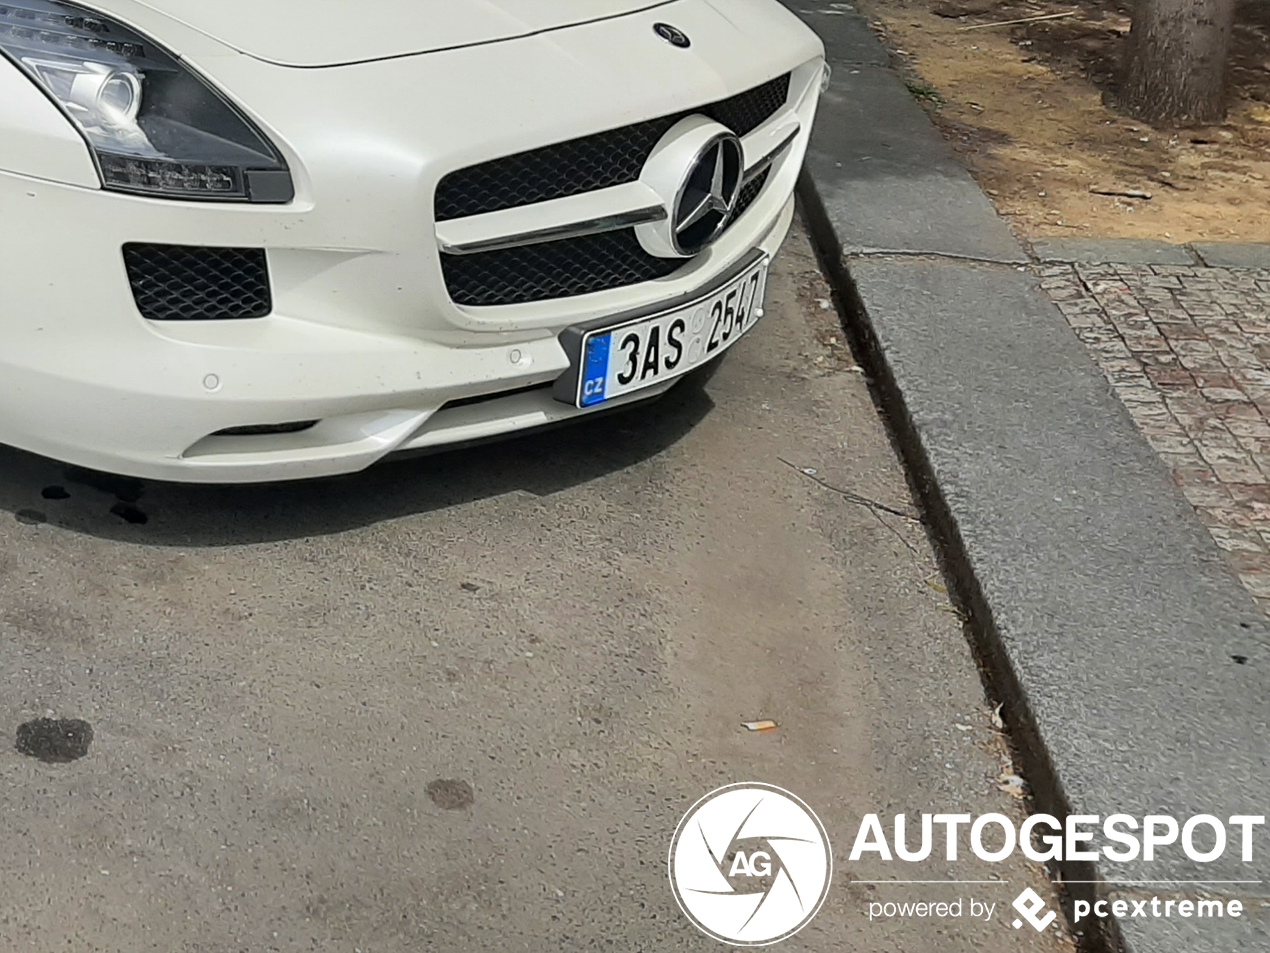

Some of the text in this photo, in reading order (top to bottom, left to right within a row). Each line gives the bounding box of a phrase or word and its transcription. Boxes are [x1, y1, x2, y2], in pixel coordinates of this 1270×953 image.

[584, 269, 760, 396] CZ 3AS 2547
